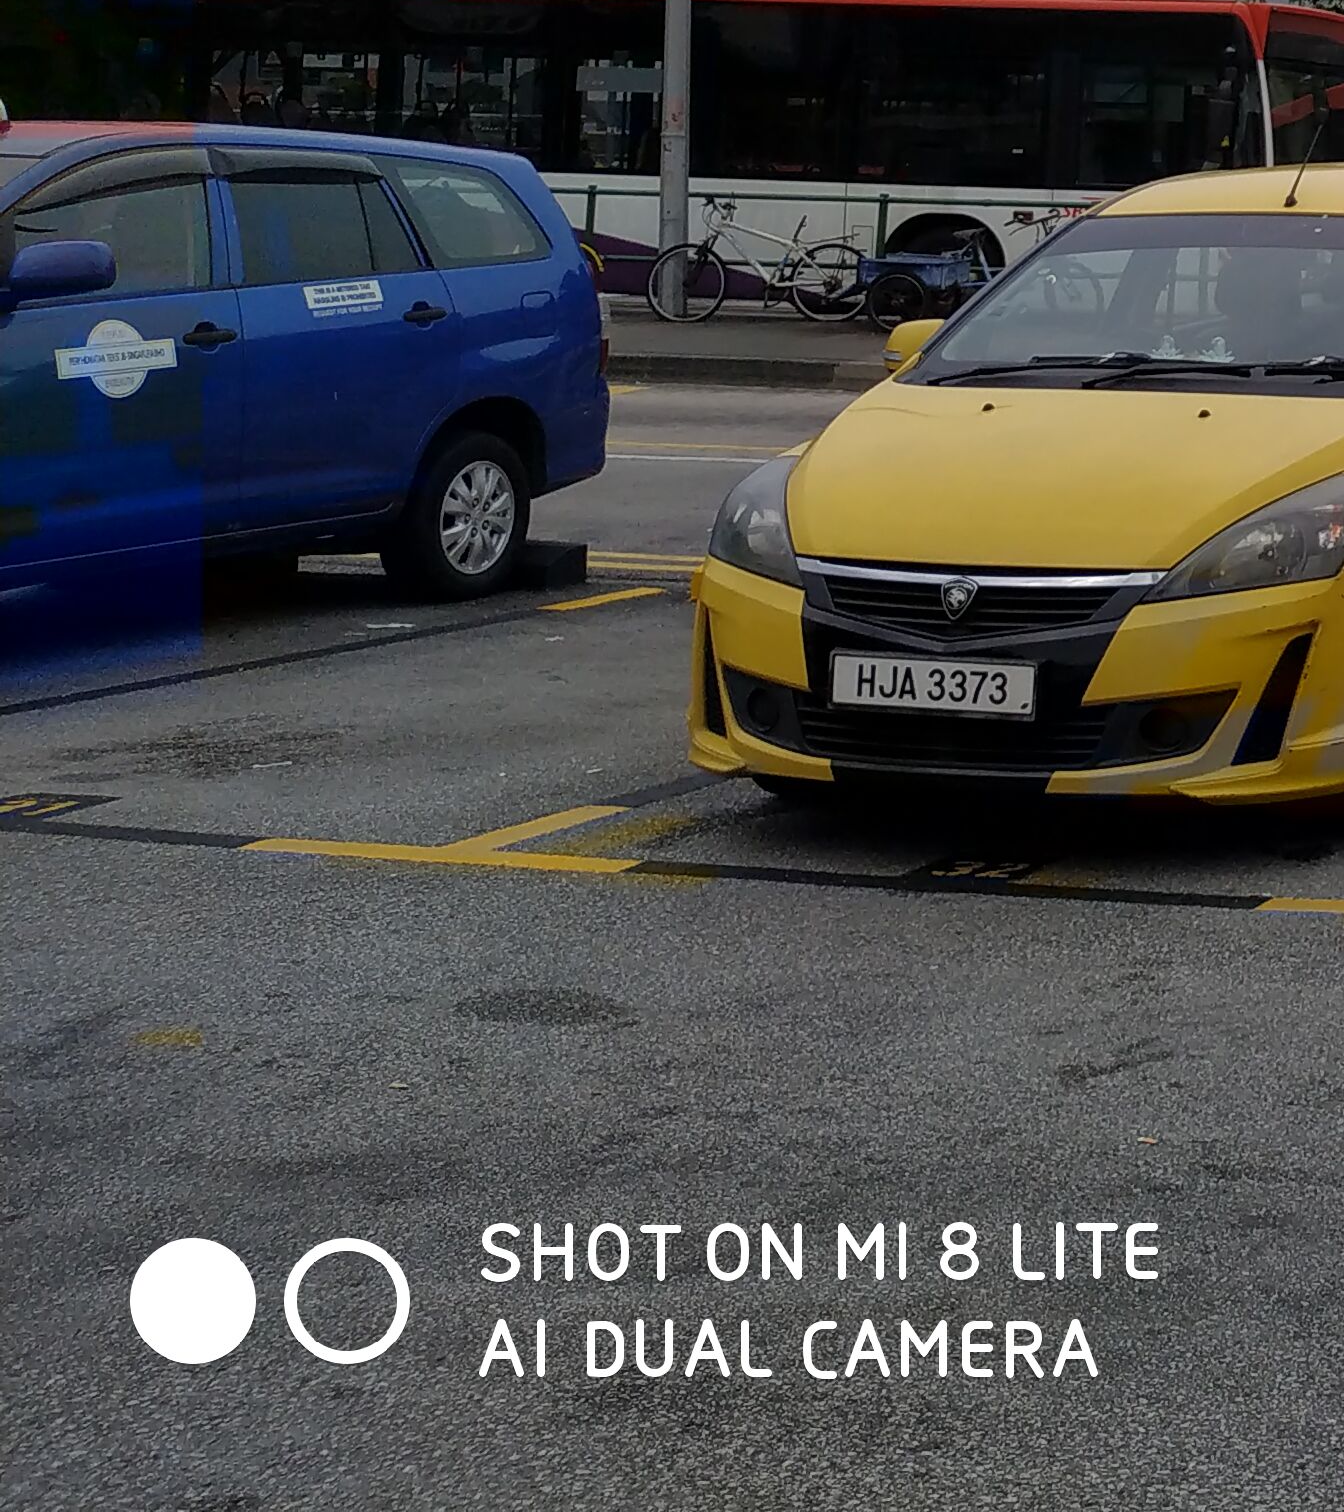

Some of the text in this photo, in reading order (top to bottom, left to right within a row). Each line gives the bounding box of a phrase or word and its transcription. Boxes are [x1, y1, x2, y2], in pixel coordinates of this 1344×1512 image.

[856, 663, 1008, 705] HJA 3373
[931, 860, 1029, 878] 32
